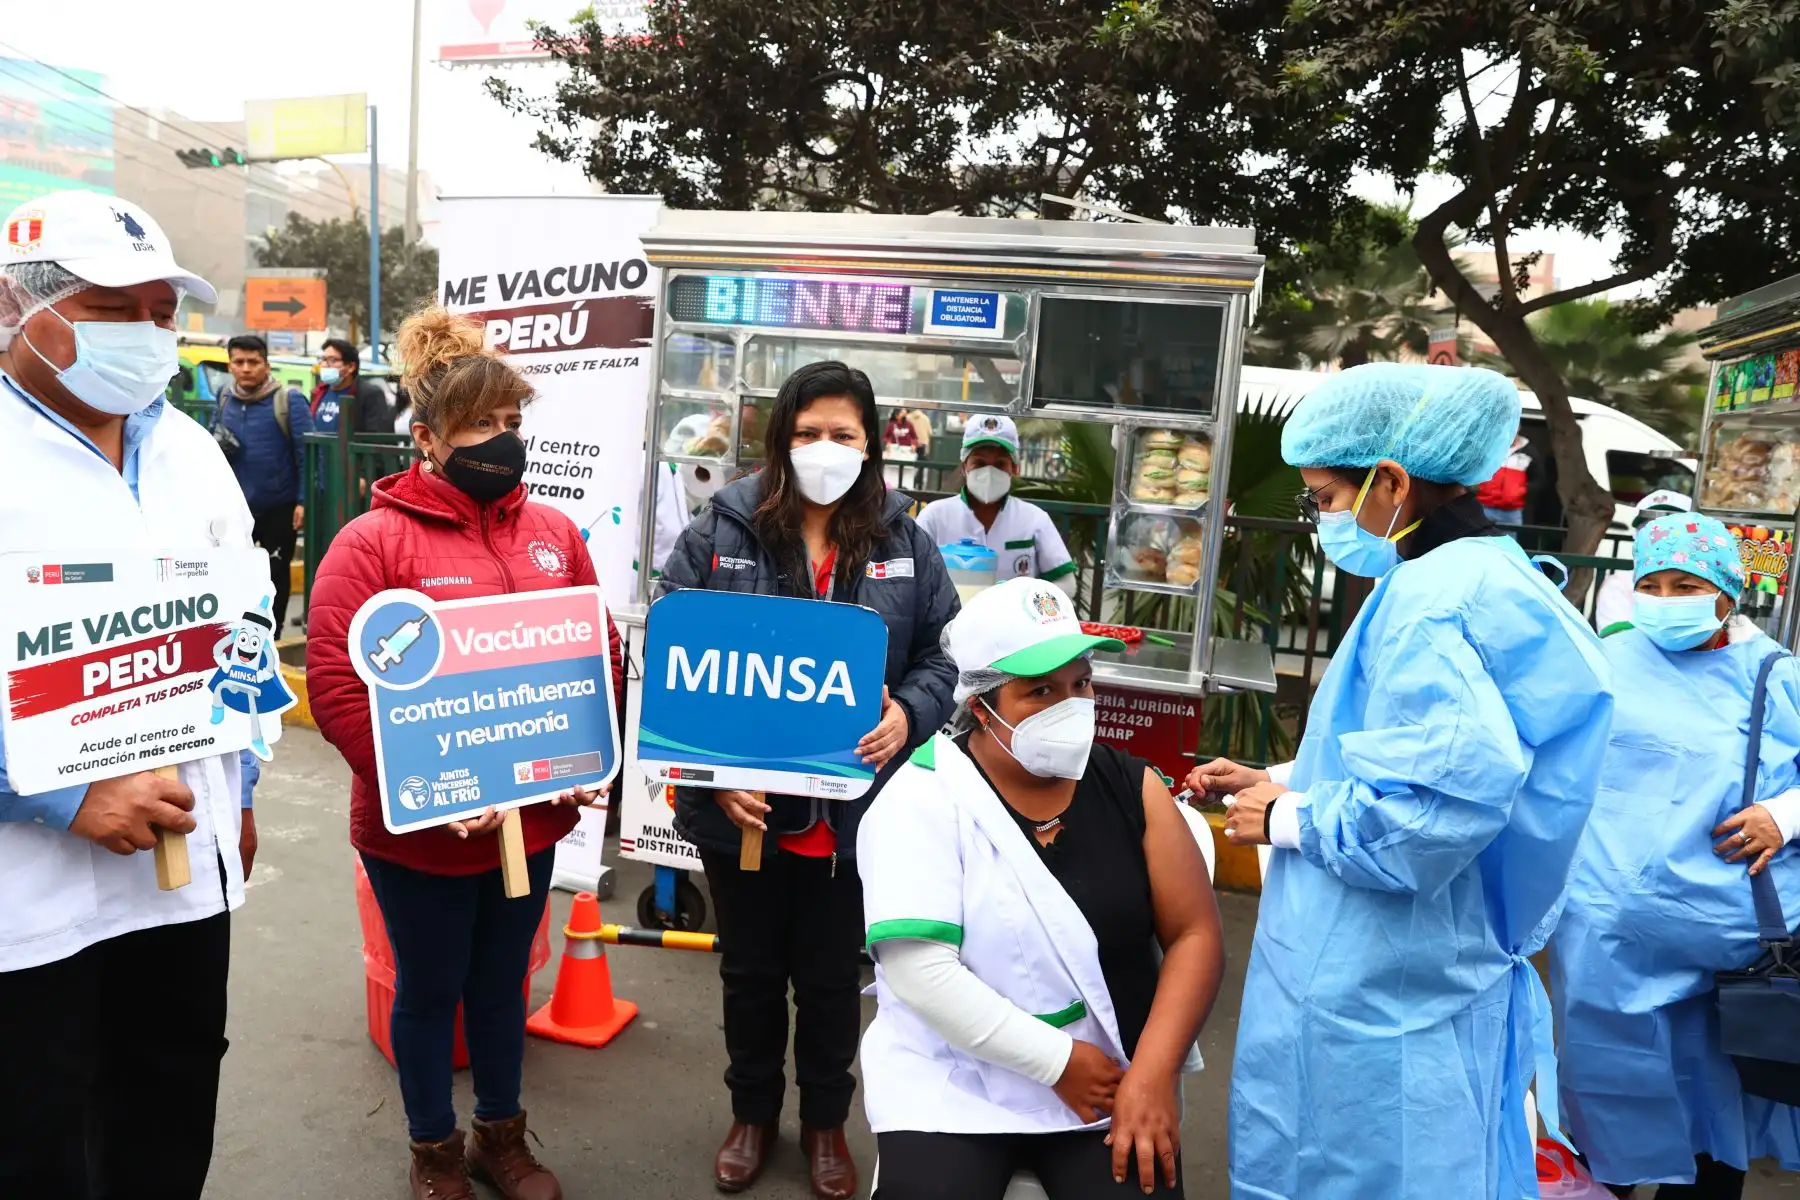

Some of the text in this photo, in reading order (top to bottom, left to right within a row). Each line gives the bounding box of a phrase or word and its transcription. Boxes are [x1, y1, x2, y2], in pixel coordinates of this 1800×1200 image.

[594, 6, 643, 18] PULAR
[444, 258, 648, 307] ME VACUNO
[706, 278, 903, 330] BIENVE
[940, 296, 979, 304] MANTENER
[946, 305, 982, 314] DISTANCIA
[486, 300, 589, 351] PERÚ
[940, 314, 986, 324] OBLIGATORIA
[554, 361, 580, 374] QUE
[582, 360, 598, 370] TE
[600, 356, 640, 370] FALTA
[540, 440, 600, 458] centro
[524, 482, 585, 500] rcano
[174, 560, 208, 570] Siempre
[187, 570, 209, 578] pueblo
[421, 576, 472, 588] FUNCIONARIA
[18, 593, 218, 662] ME VACUNO
[450, 618, 593, 656] Vacúnate
[82, 634, 182, 697] PERÚ
[229, 668, 258, 684] MINSA
[666, 646, 856, 707] MINSA
[70, 678, 204, 727] COMPLETA TUS DOSIS
[389, 678, 596, 726] contra la influenza
[1094, 694, 1196, 718] ERÍA JURÍDICA
[1095, 710, 1153, 728] 1242420
[80, 724, 196, 755] Acude al centro de
[436, 710, 569, 756] y neumonía
[58, 736, 216, 775] vacunación más cercano
[440, 768, 470, 781] JUNTOS
[432, 776, 479, 792] VENCEREMOS
[820, 780, 848, 788] Siempre
[434, 785, 480, 806] AL FRÍO
[570, 829, 586, 838] pre
[642, 824, 684, 841] MUNIC
